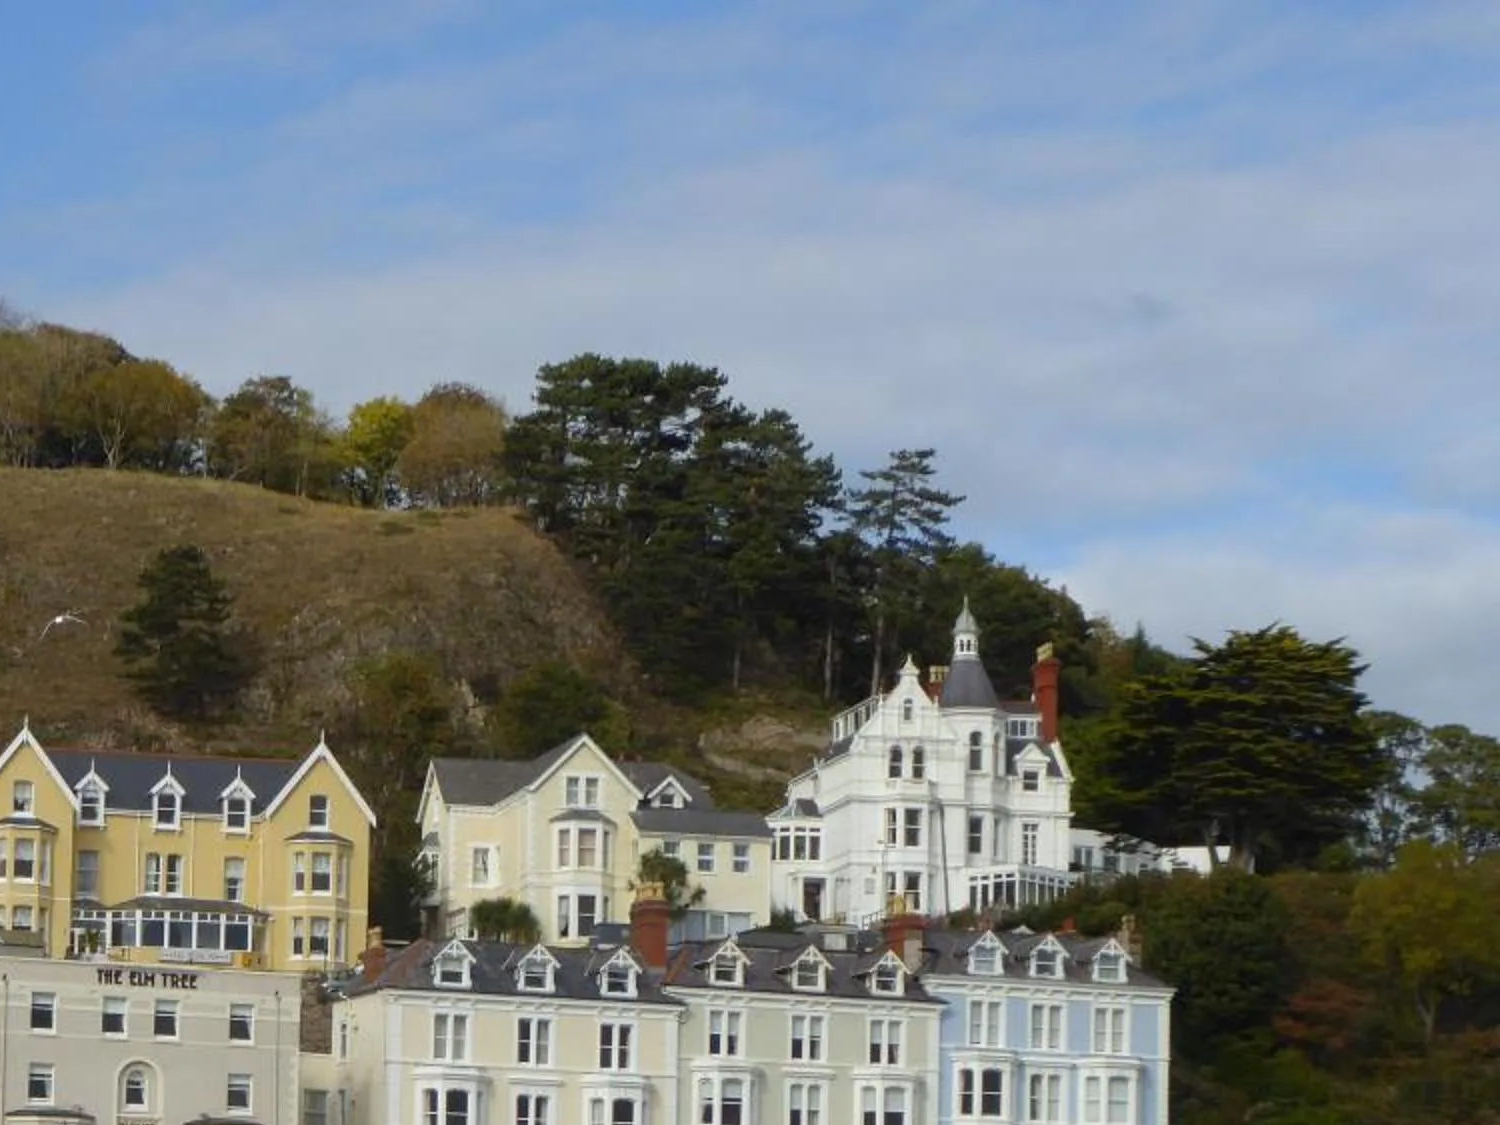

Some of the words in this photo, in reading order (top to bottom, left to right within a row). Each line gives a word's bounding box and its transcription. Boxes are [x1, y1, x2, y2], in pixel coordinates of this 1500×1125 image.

[96, 967, 124, 985] THE
[128, 970, 155, 987] ELM
[161, 972, 199, 990] TREE
